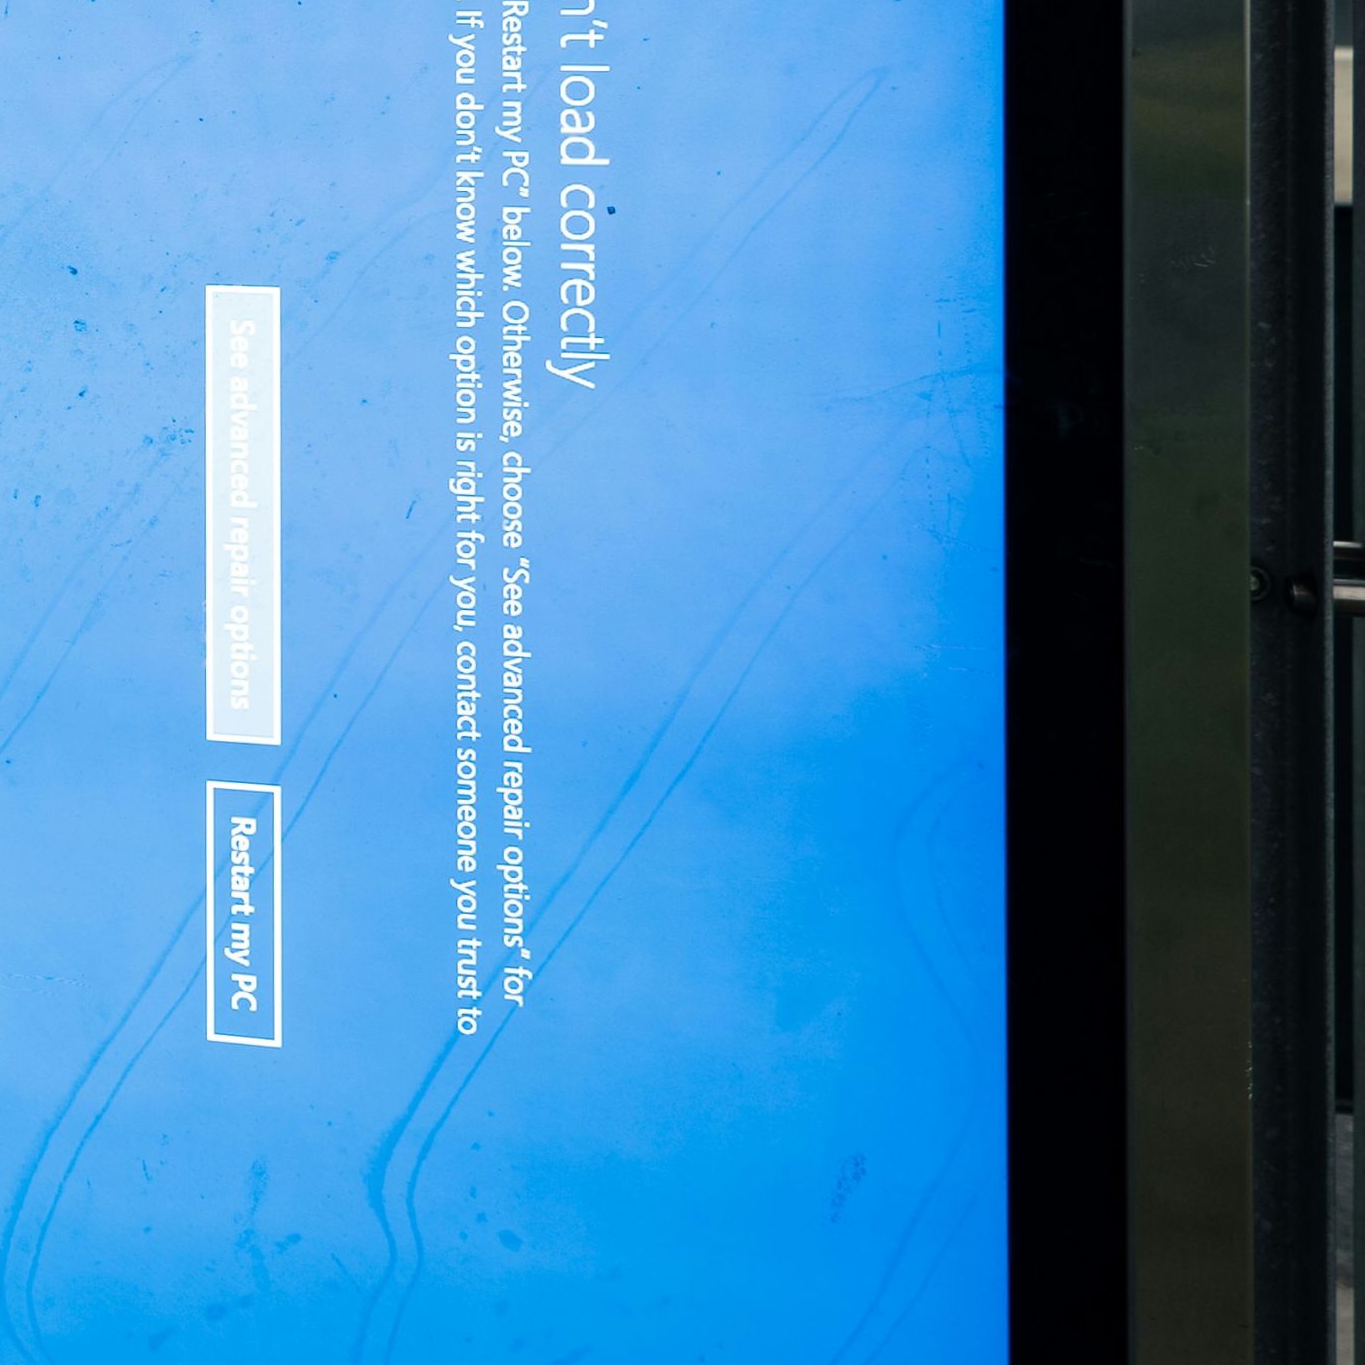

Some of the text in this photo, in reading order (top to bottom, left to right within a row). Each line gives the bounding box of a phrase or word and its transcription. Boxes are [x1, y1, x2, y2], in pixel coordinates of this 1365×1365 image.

[448, 33, 476, 85] you
[455, 10, 485, 29] If
[494, 100, 522, 143] my
[559, 64, 611, 166] load
[455, 171, 485, 244] know
[455, 249, 486, 328] which
[501, 206, 532, 292] below.
[546, 183, 611, 389] correctly
[448, 335, 483, 425] option
[499, 300, 532, 443] Otherwise,
[455, 431, 484, 452] is
[222, 320, 259, 710] See advanced repair options
[448, 460, 486, 525] right
[501, 451, 532, 549] choose
[455, 529, 486, 571] for
[449, 574, 477, 632] you,
[456, 640, 483, 742] contact
[502, 623, 533, 754] advanced
[456, 747, 478, 873] someone
[495, 760, 531, 841] repair
[223, 816, 258, 1012] Restart my PC
[449, 878, 478, 931] you
[456, 936, 483, 1000] trust
[501, 964, 534, 1008] for
[455, 1006, 483, 1037] to
